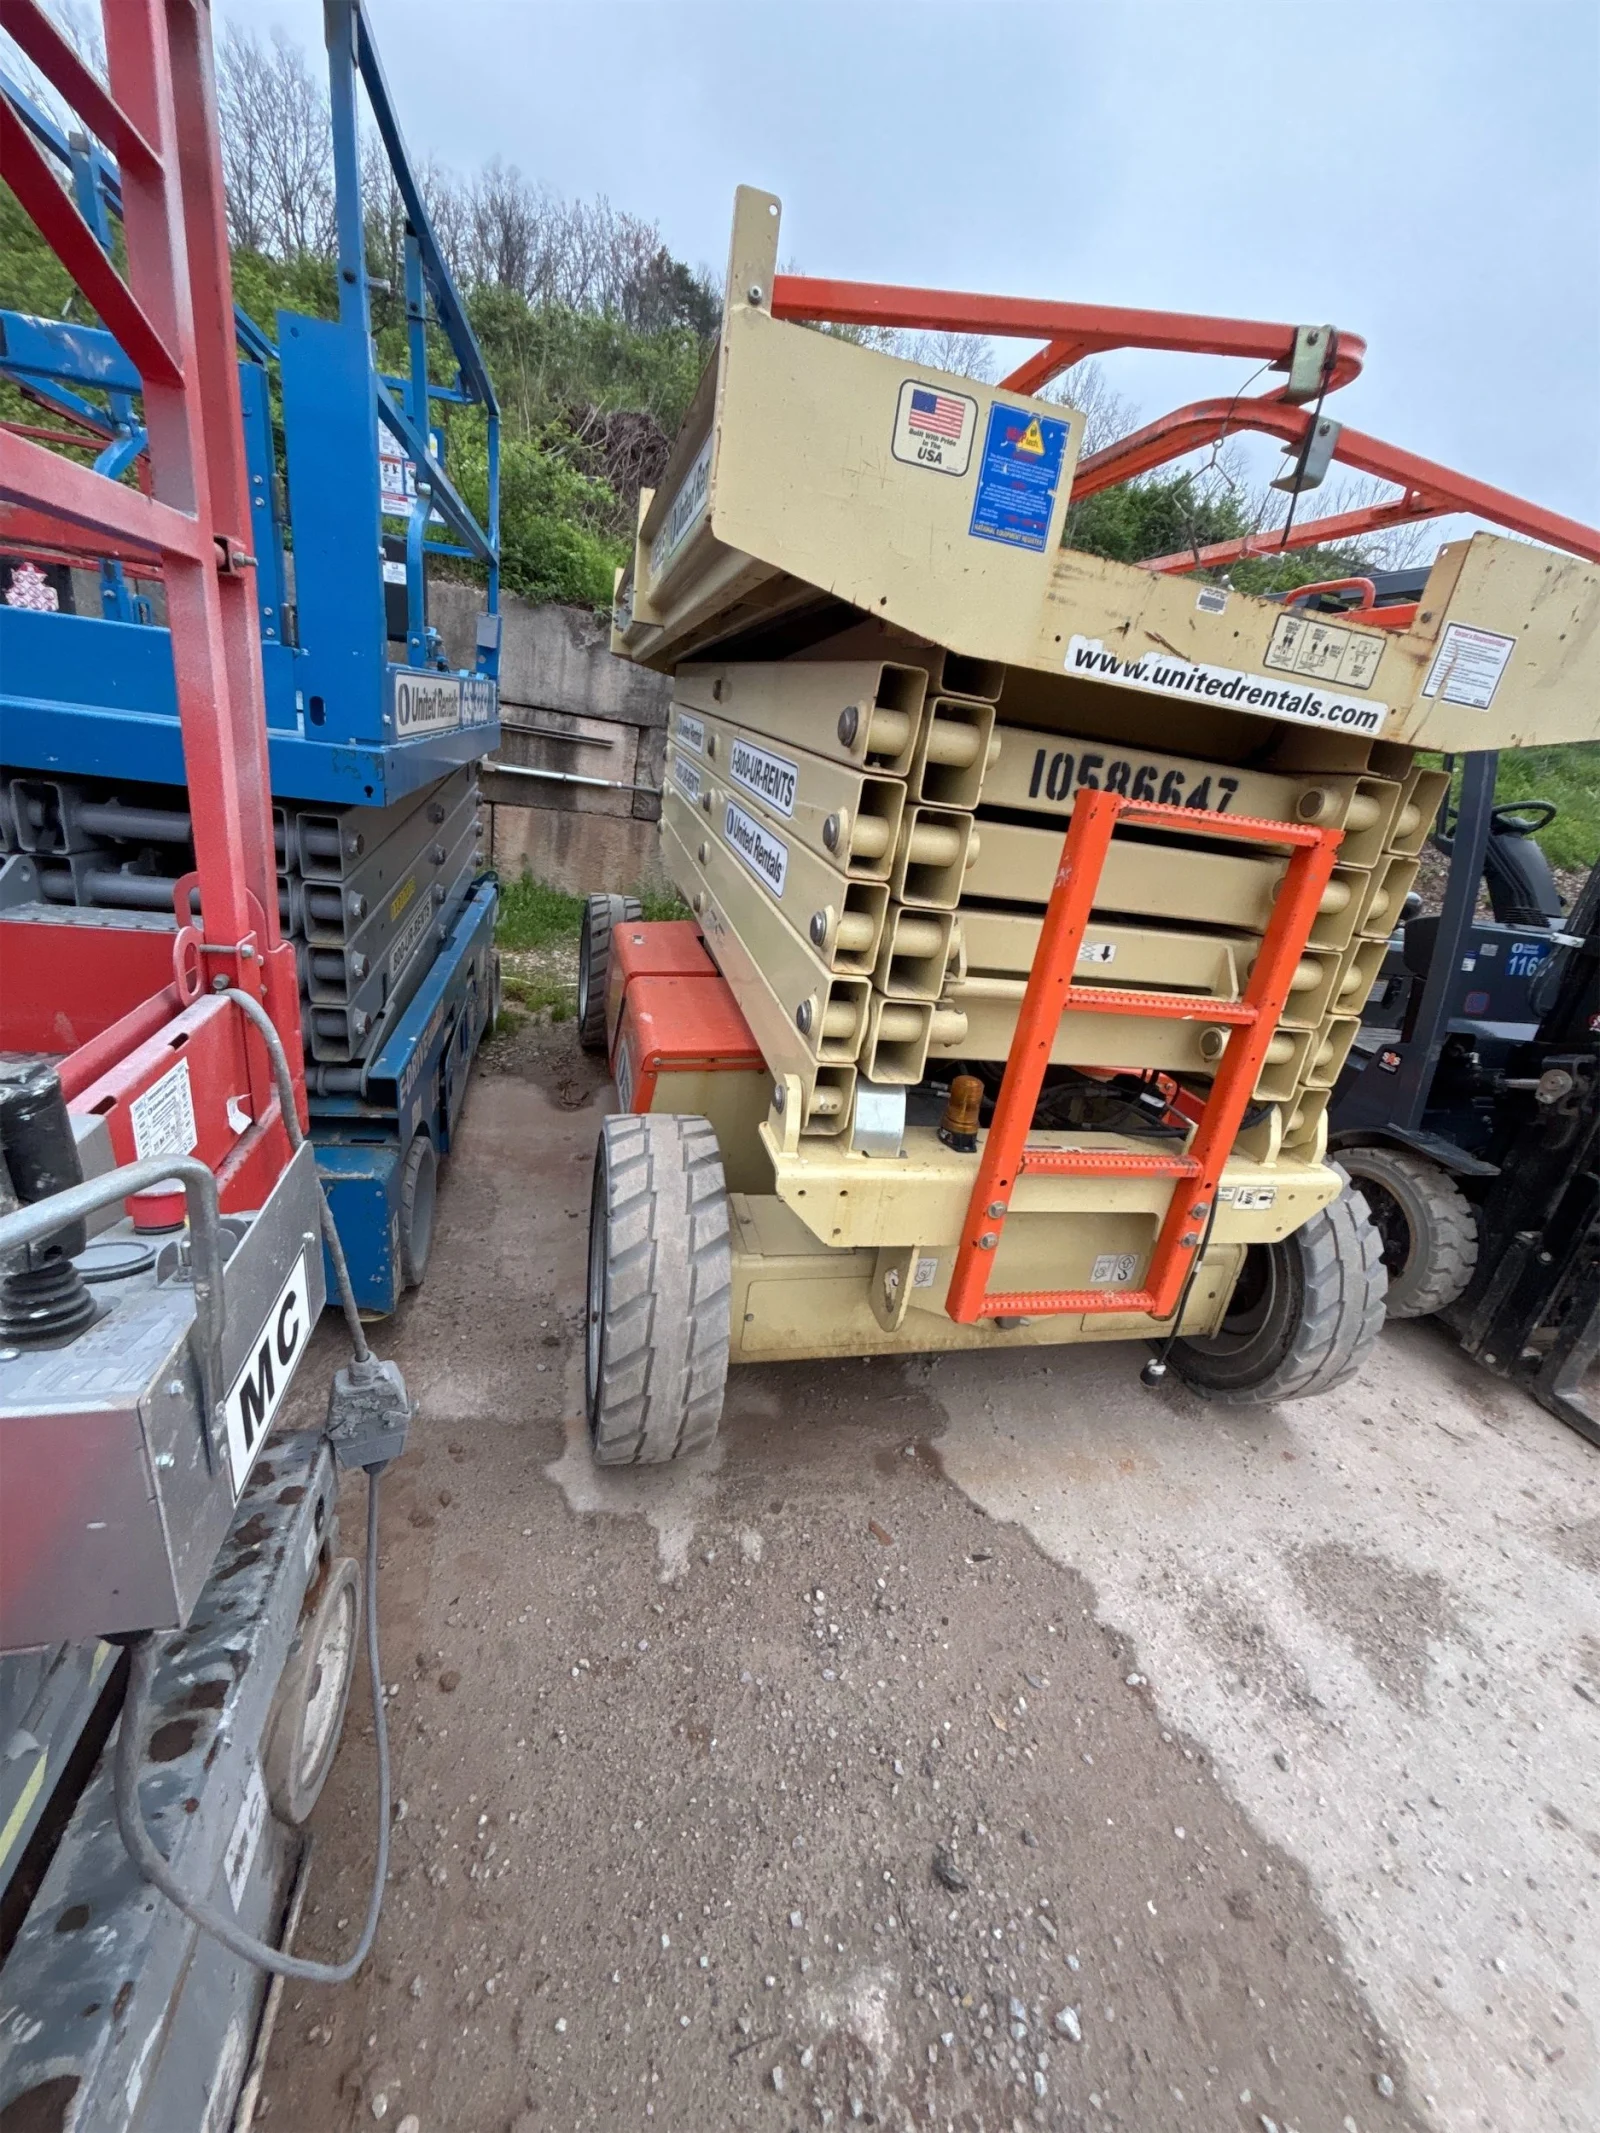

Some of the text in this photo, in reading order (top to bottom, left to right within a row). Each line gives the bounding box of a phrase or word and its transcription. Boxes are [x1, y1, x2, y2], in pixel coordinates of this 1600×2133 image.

[908, 428, 957, 447] Built With Pride
[917, 446, 943, 465] USA
[411, 686, 436, 722] United
[437, 687, 458, 718] Rentals
[1074, 647, 1379, 730] www.unitedrentals.com
[732, 746, 795, 807] 1-800-UR-RENTS
[1028, 748, 1239, 814] 10586647
[734, 816, 782, 884] United Rentals
[239, 1290, 300, 1455] MC
